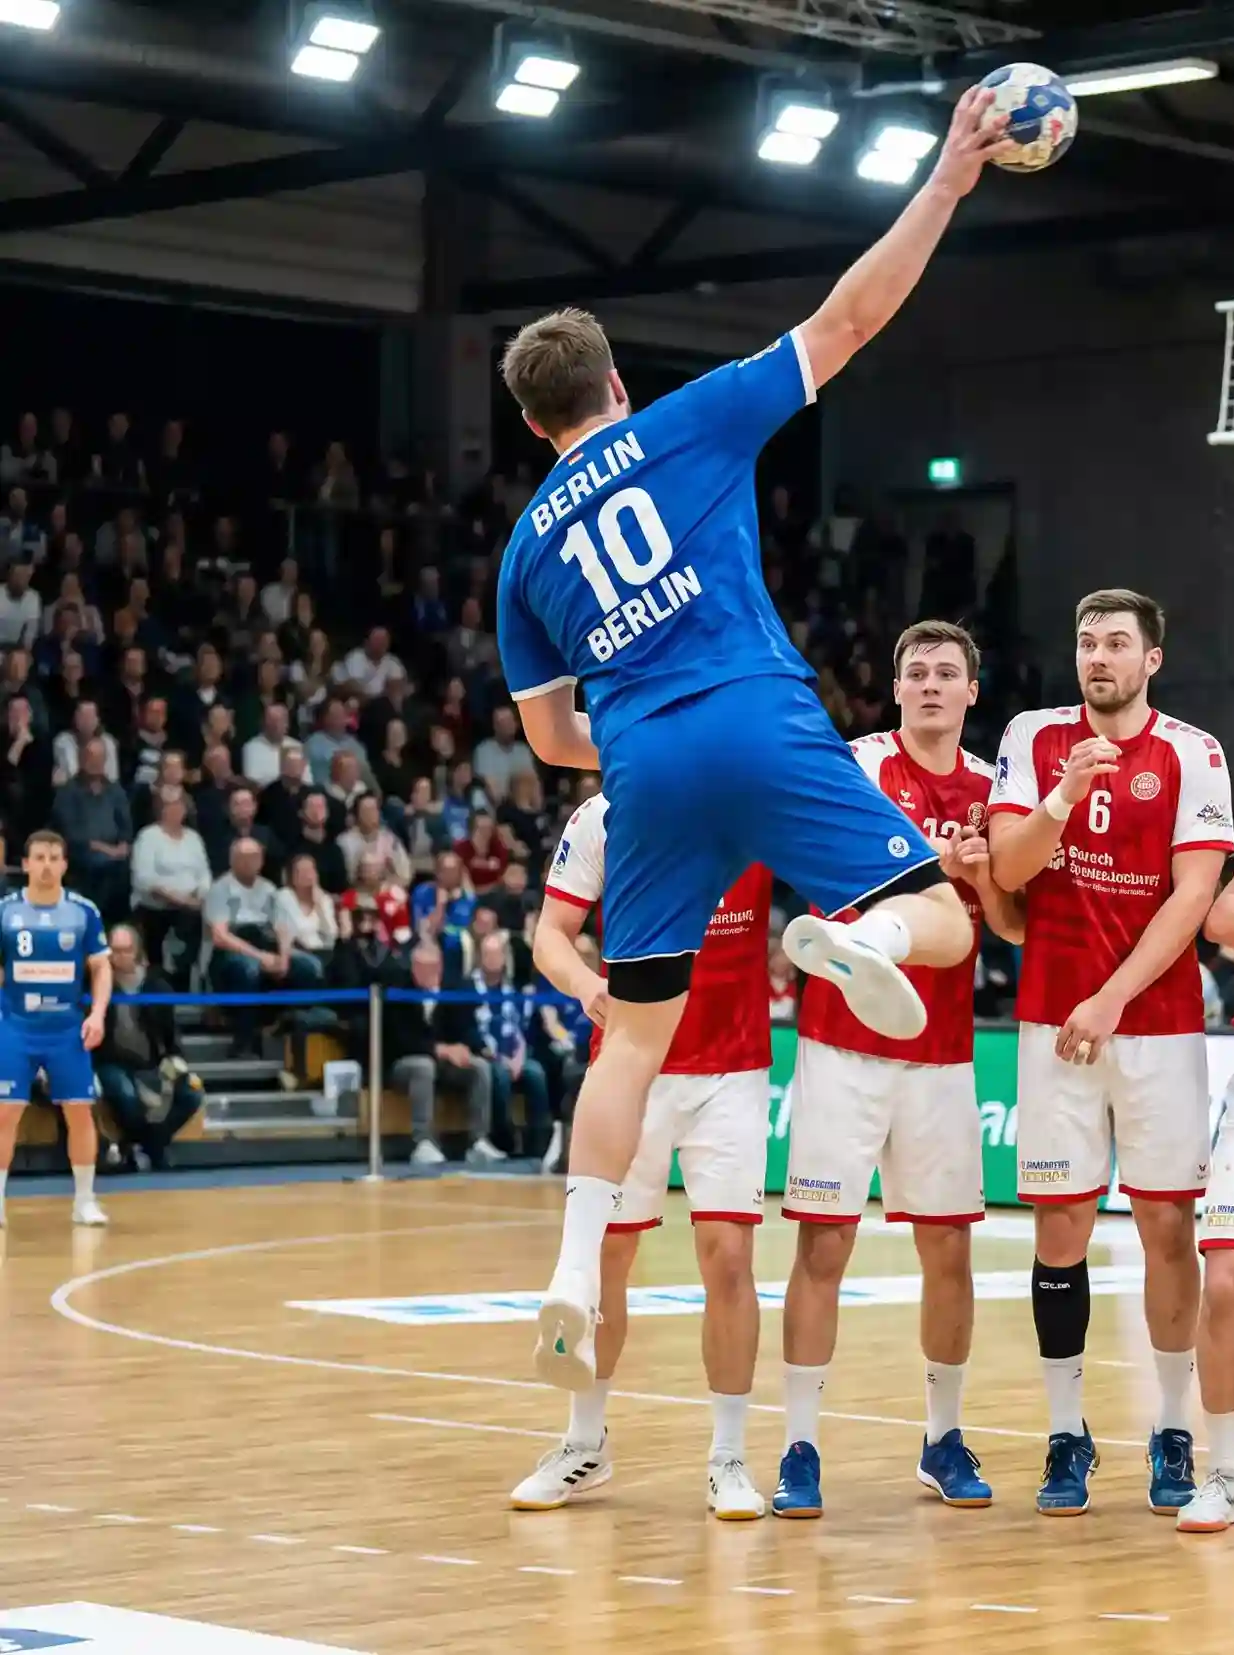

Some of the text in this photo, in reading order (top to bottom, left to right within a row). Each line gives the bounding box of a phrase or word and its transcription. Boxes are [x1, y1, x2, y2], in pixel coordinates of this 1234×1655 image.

[531, 431, 646, 537] BERLIN
[559, 487, 674, 614] 10
[587, 566, 702, 663] BERLIN
[1088, 789, 1112, 834] 6
[17, 930, 33, 957] 8
